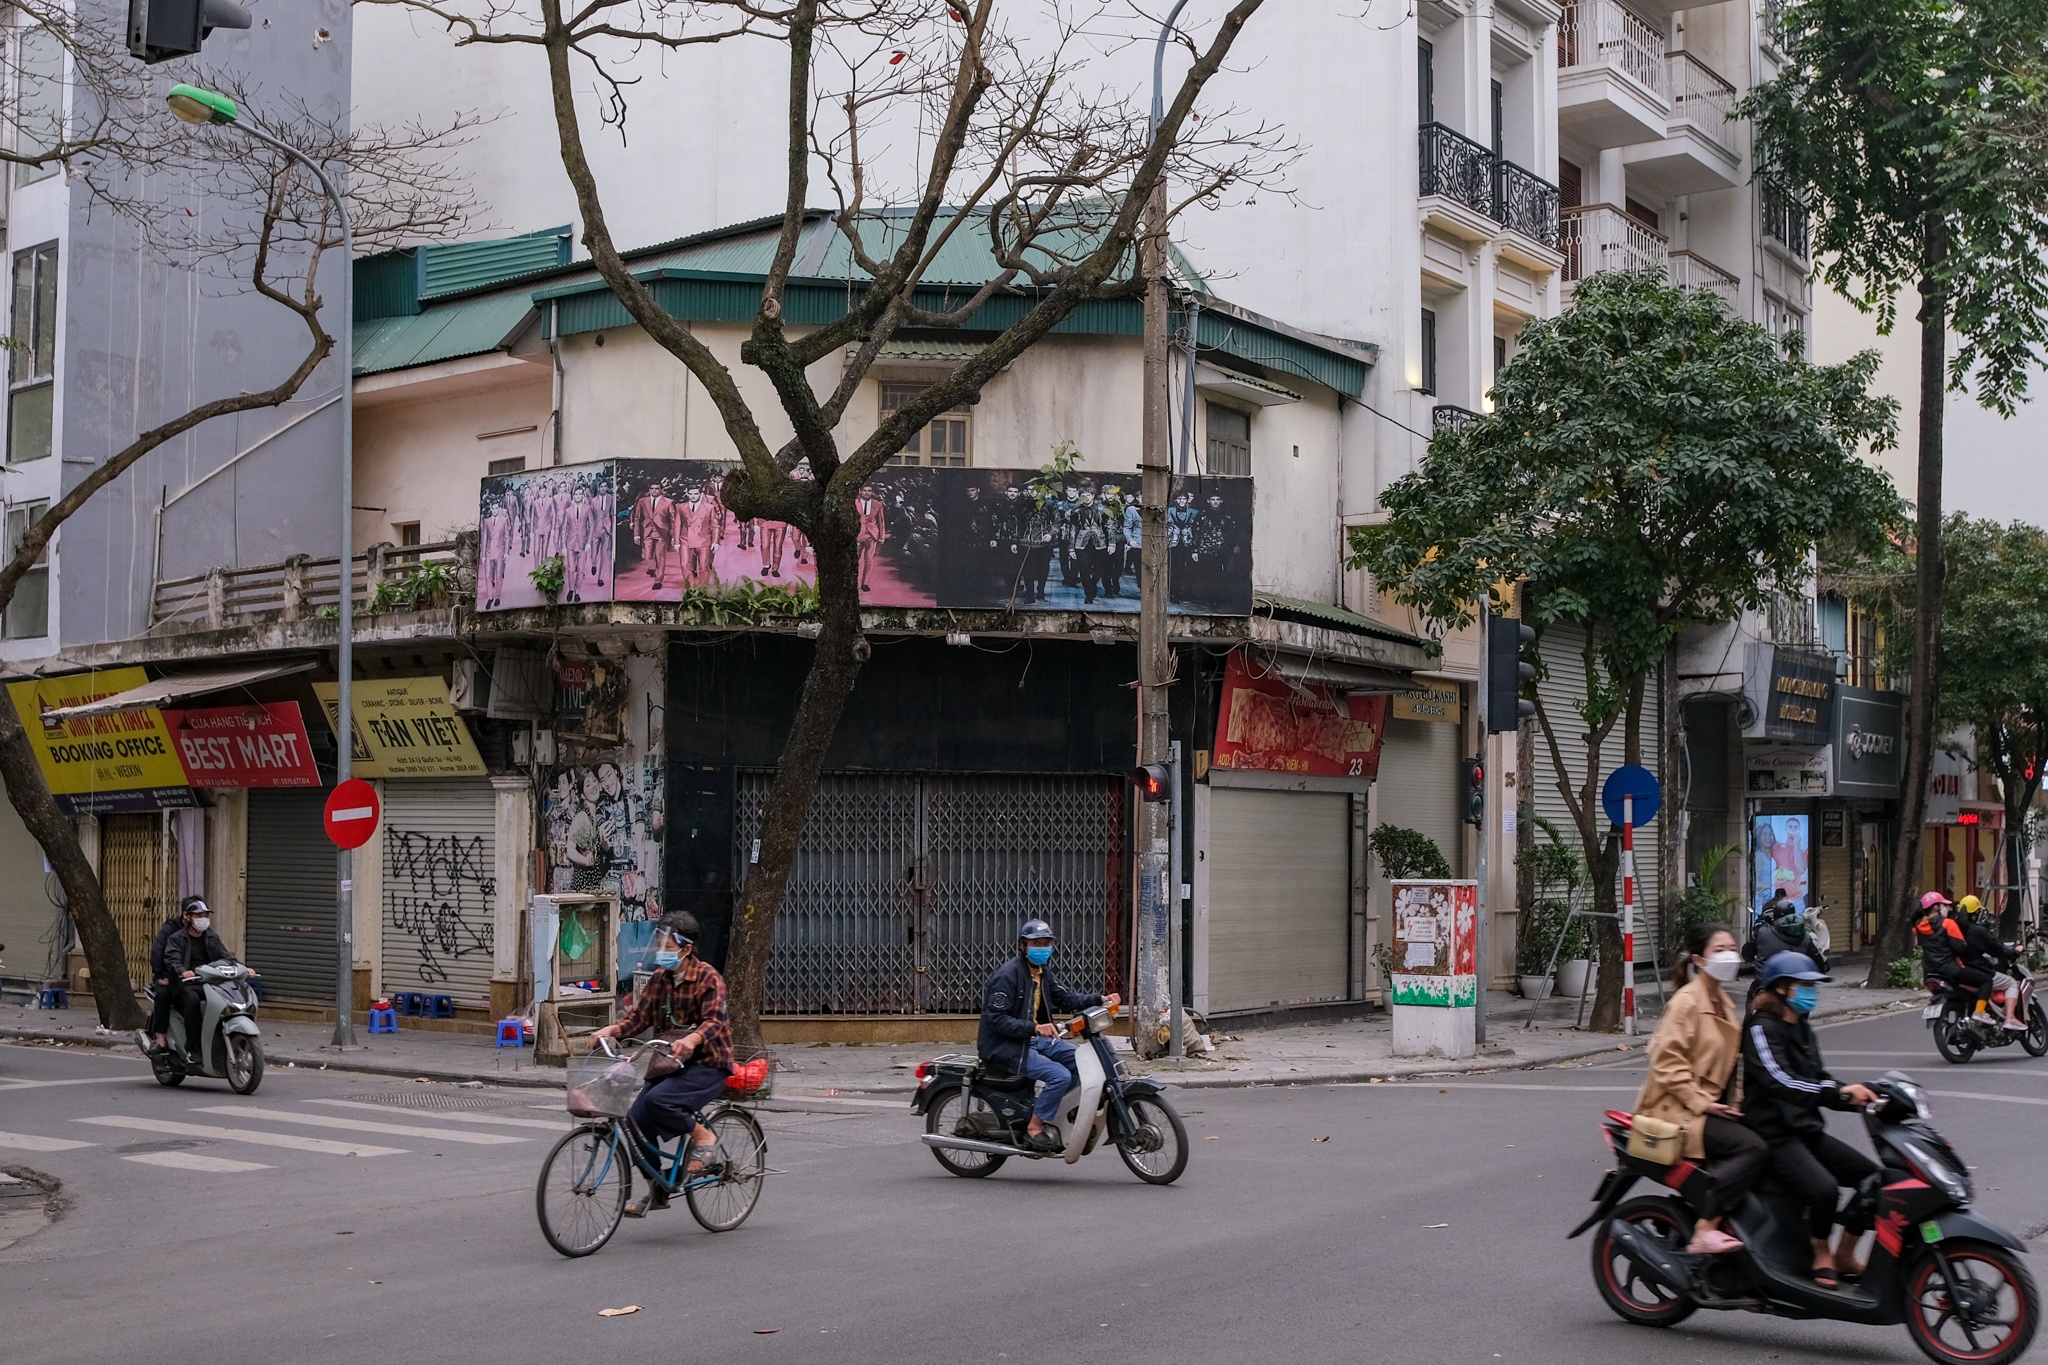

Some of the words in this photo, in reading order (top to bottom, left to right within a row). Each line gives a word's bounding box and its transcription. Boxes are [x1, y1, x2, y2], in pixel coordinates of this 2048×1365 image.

[361, 700, 385, 708] CERAMIC
[389, 699, 405, 707] STONE
[409, 698, 426, 706] SILVER
[429, 697, 445, 705] BONE
[386, 688, 409, 696] ANTIQUE
[368, 712, 416, 748] TÂN
[411, 710, 462, 753] VIỆT
[51, 741, 114, 764] BOOKING
[116, 736, 166, 759] OFFICE
[180, 736, 236, 770] BEST
[236, 733, 301, 769] MART
[1862, 732, 1894, 755] JOCKEY
[1349, 758, 1363, 776] 23
